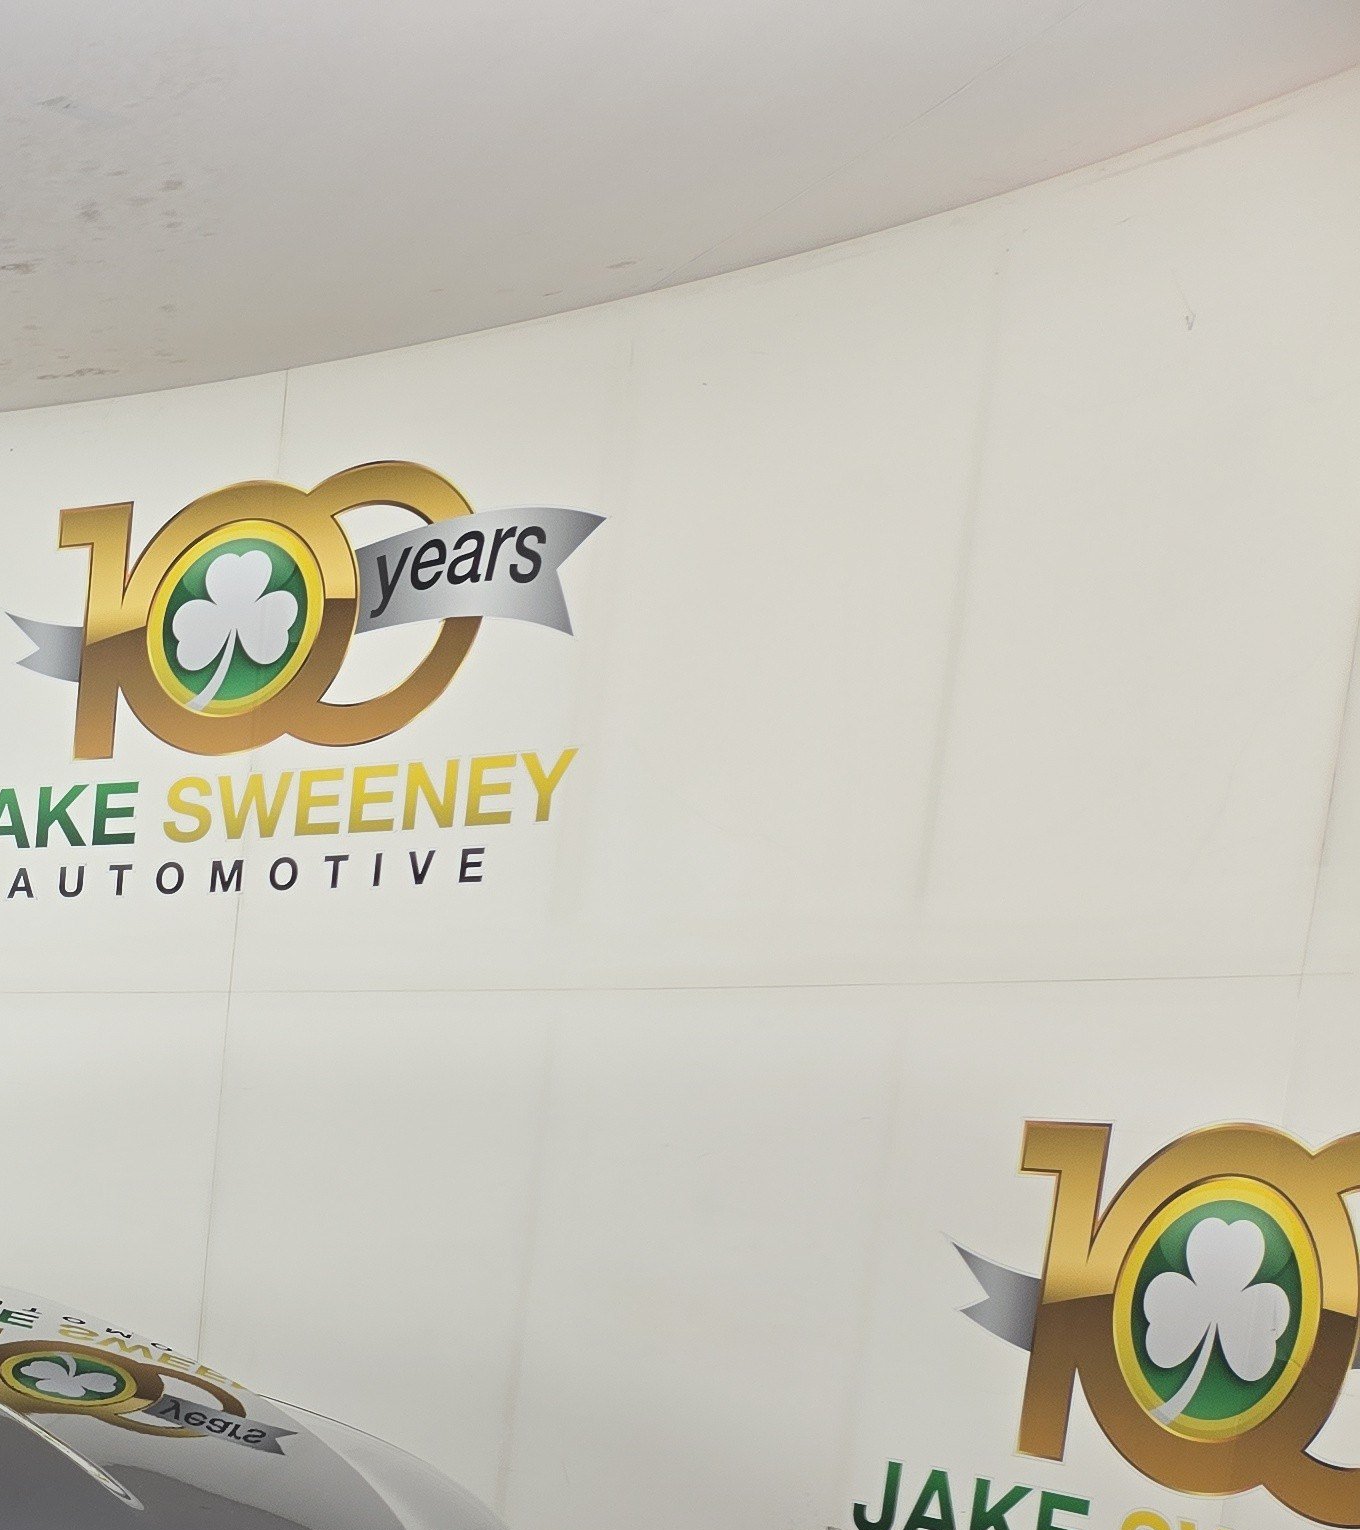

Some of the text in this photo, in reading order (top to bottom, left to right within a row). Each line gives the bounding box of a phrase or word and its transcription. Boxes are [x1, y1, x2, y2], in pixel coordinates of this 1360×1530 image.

[59, 459, 547, 762] 100 years
[162, 748, 578, 844] SWEENEY
[7, 847, 486, 899] AUTOMOTIVE
